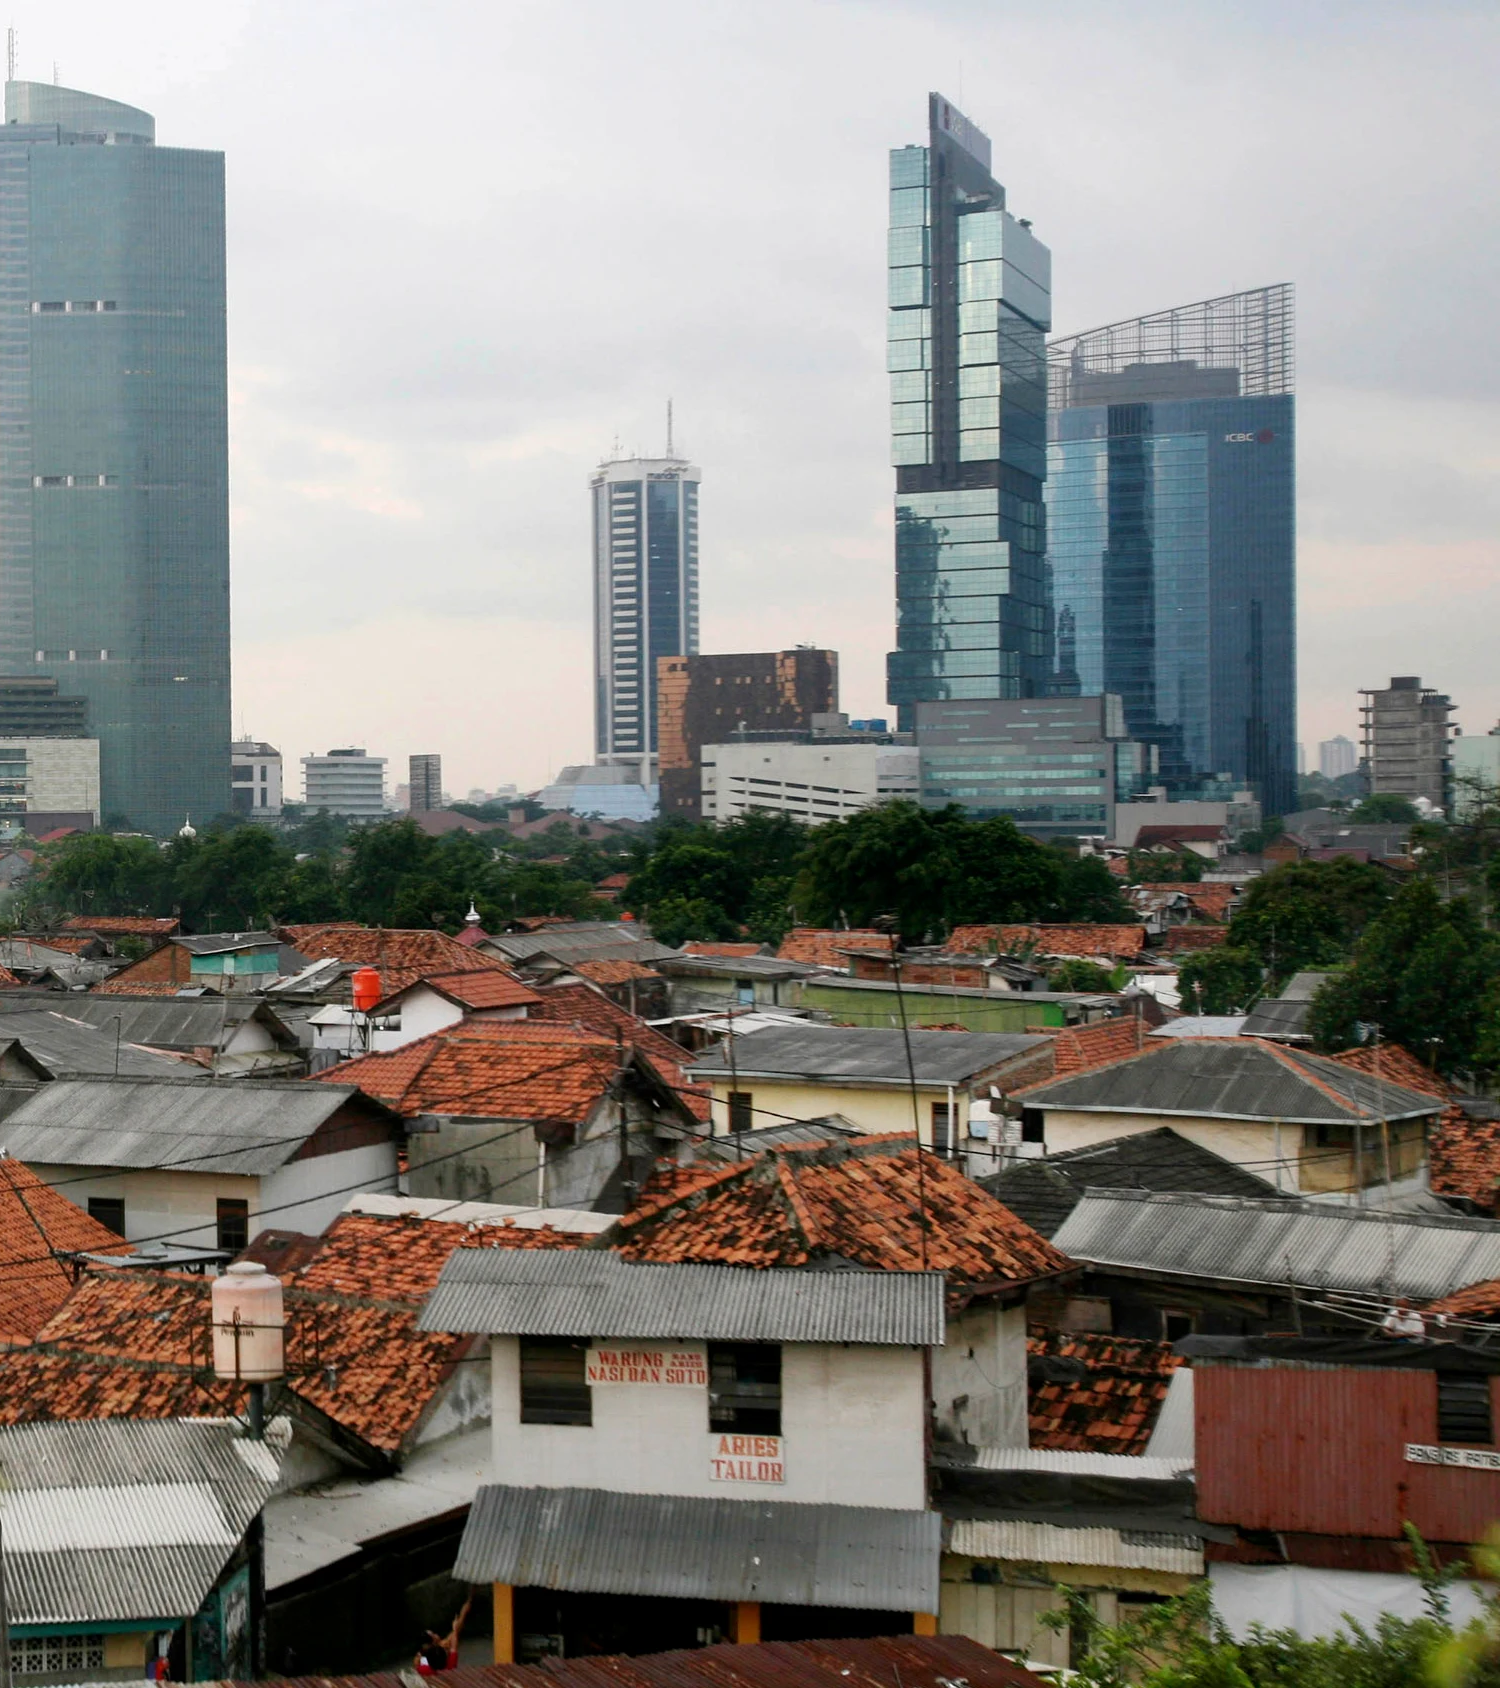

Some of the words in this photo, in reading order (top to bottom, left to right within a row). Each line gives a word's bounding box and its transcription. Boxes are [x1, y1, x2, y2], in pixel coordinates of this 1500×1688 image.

[1225, 433, 1254, 442] ICBC
[598, 1350, 664, 1368] WARUNG
[588, 1366, 624, 1382] NASI
[628, 1368, 660, 1384] DAN
[665, 1368, 706, 1385] SOTO
[718, 1435, 779, 1457] ARIES
[710, 1459, 784, 1482] TAILOR
